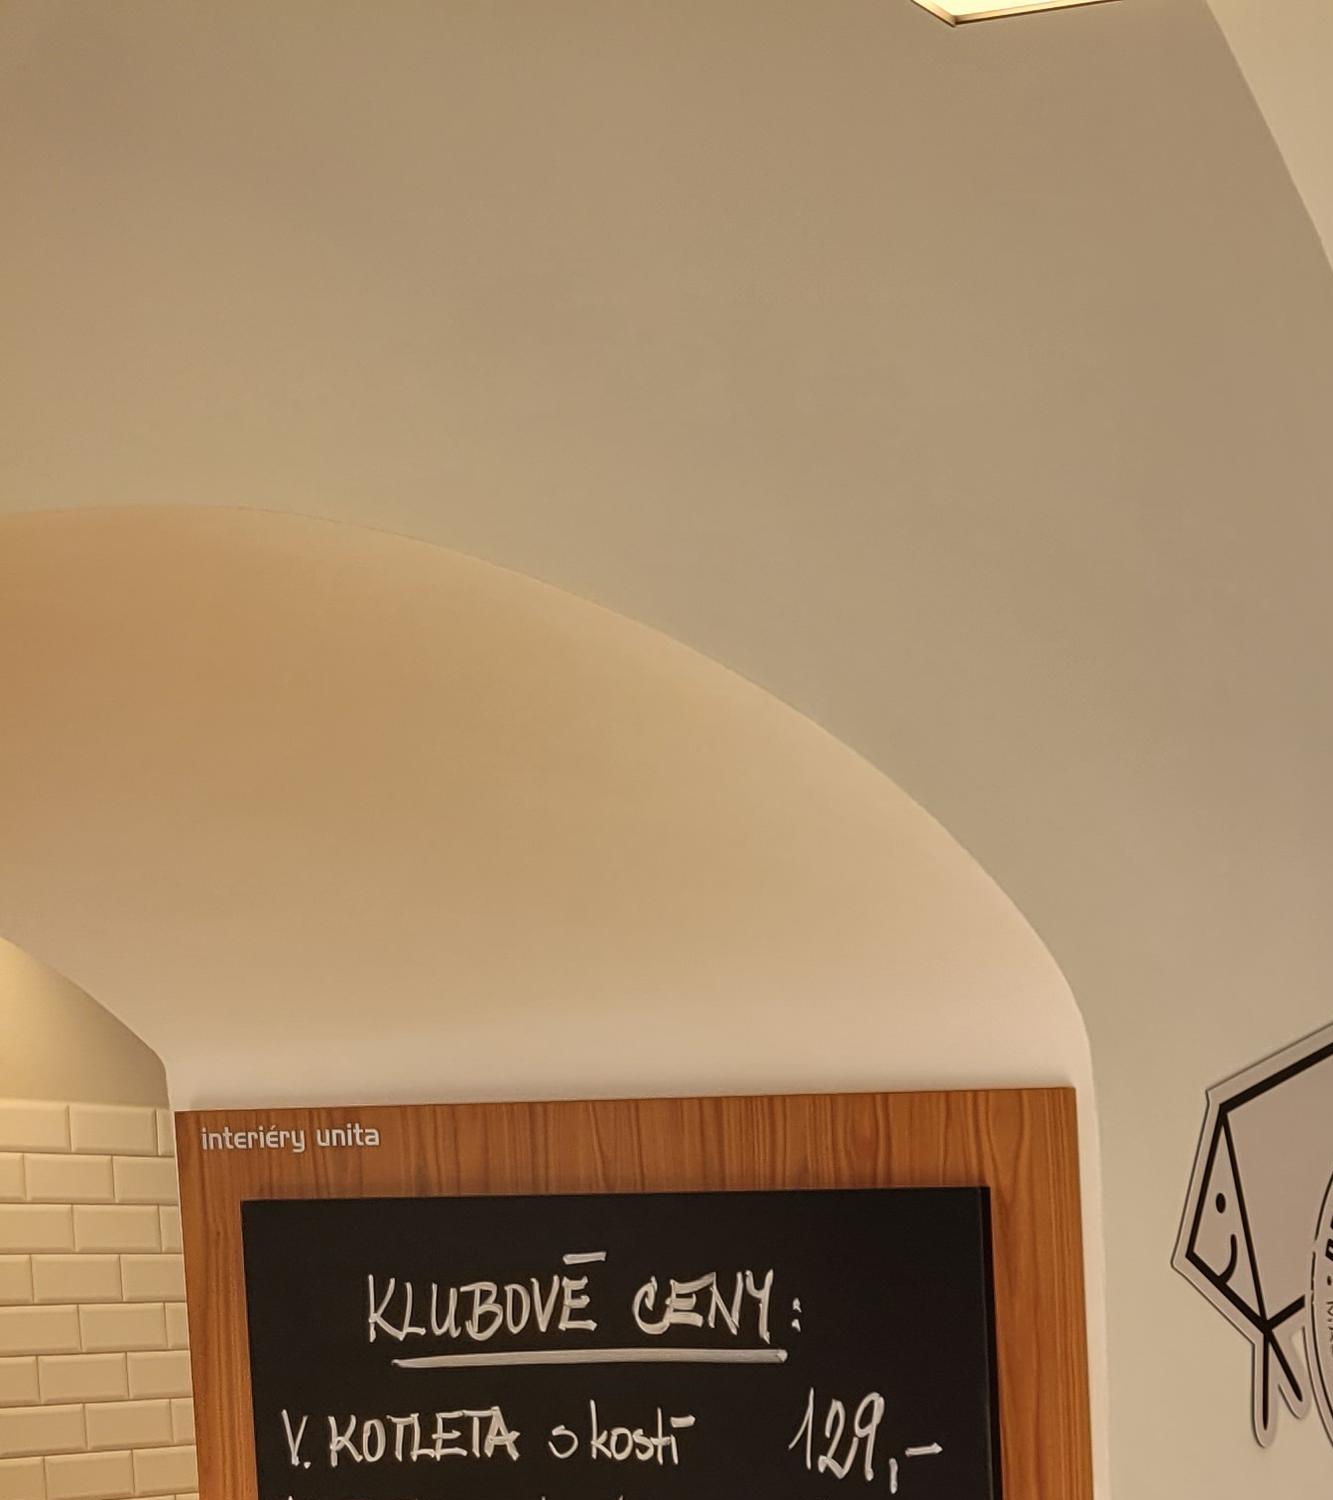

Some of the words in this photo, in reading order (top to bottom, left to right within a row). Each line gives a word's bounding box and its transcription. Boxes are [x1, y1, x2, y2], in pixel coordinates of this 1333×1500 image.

[201, 1124, 305, 1153] interiéry
[317, 1122, 380, 1148] unita
[368, 1251, 607, 1343] KLUBOVÉ
[281, 1409, 312, 1468] V.
[327, 1406, 520, 1468] KOTLETA
[548, 1424, 578, 1460] s
[591, 1400, 697, 1465] kostí
